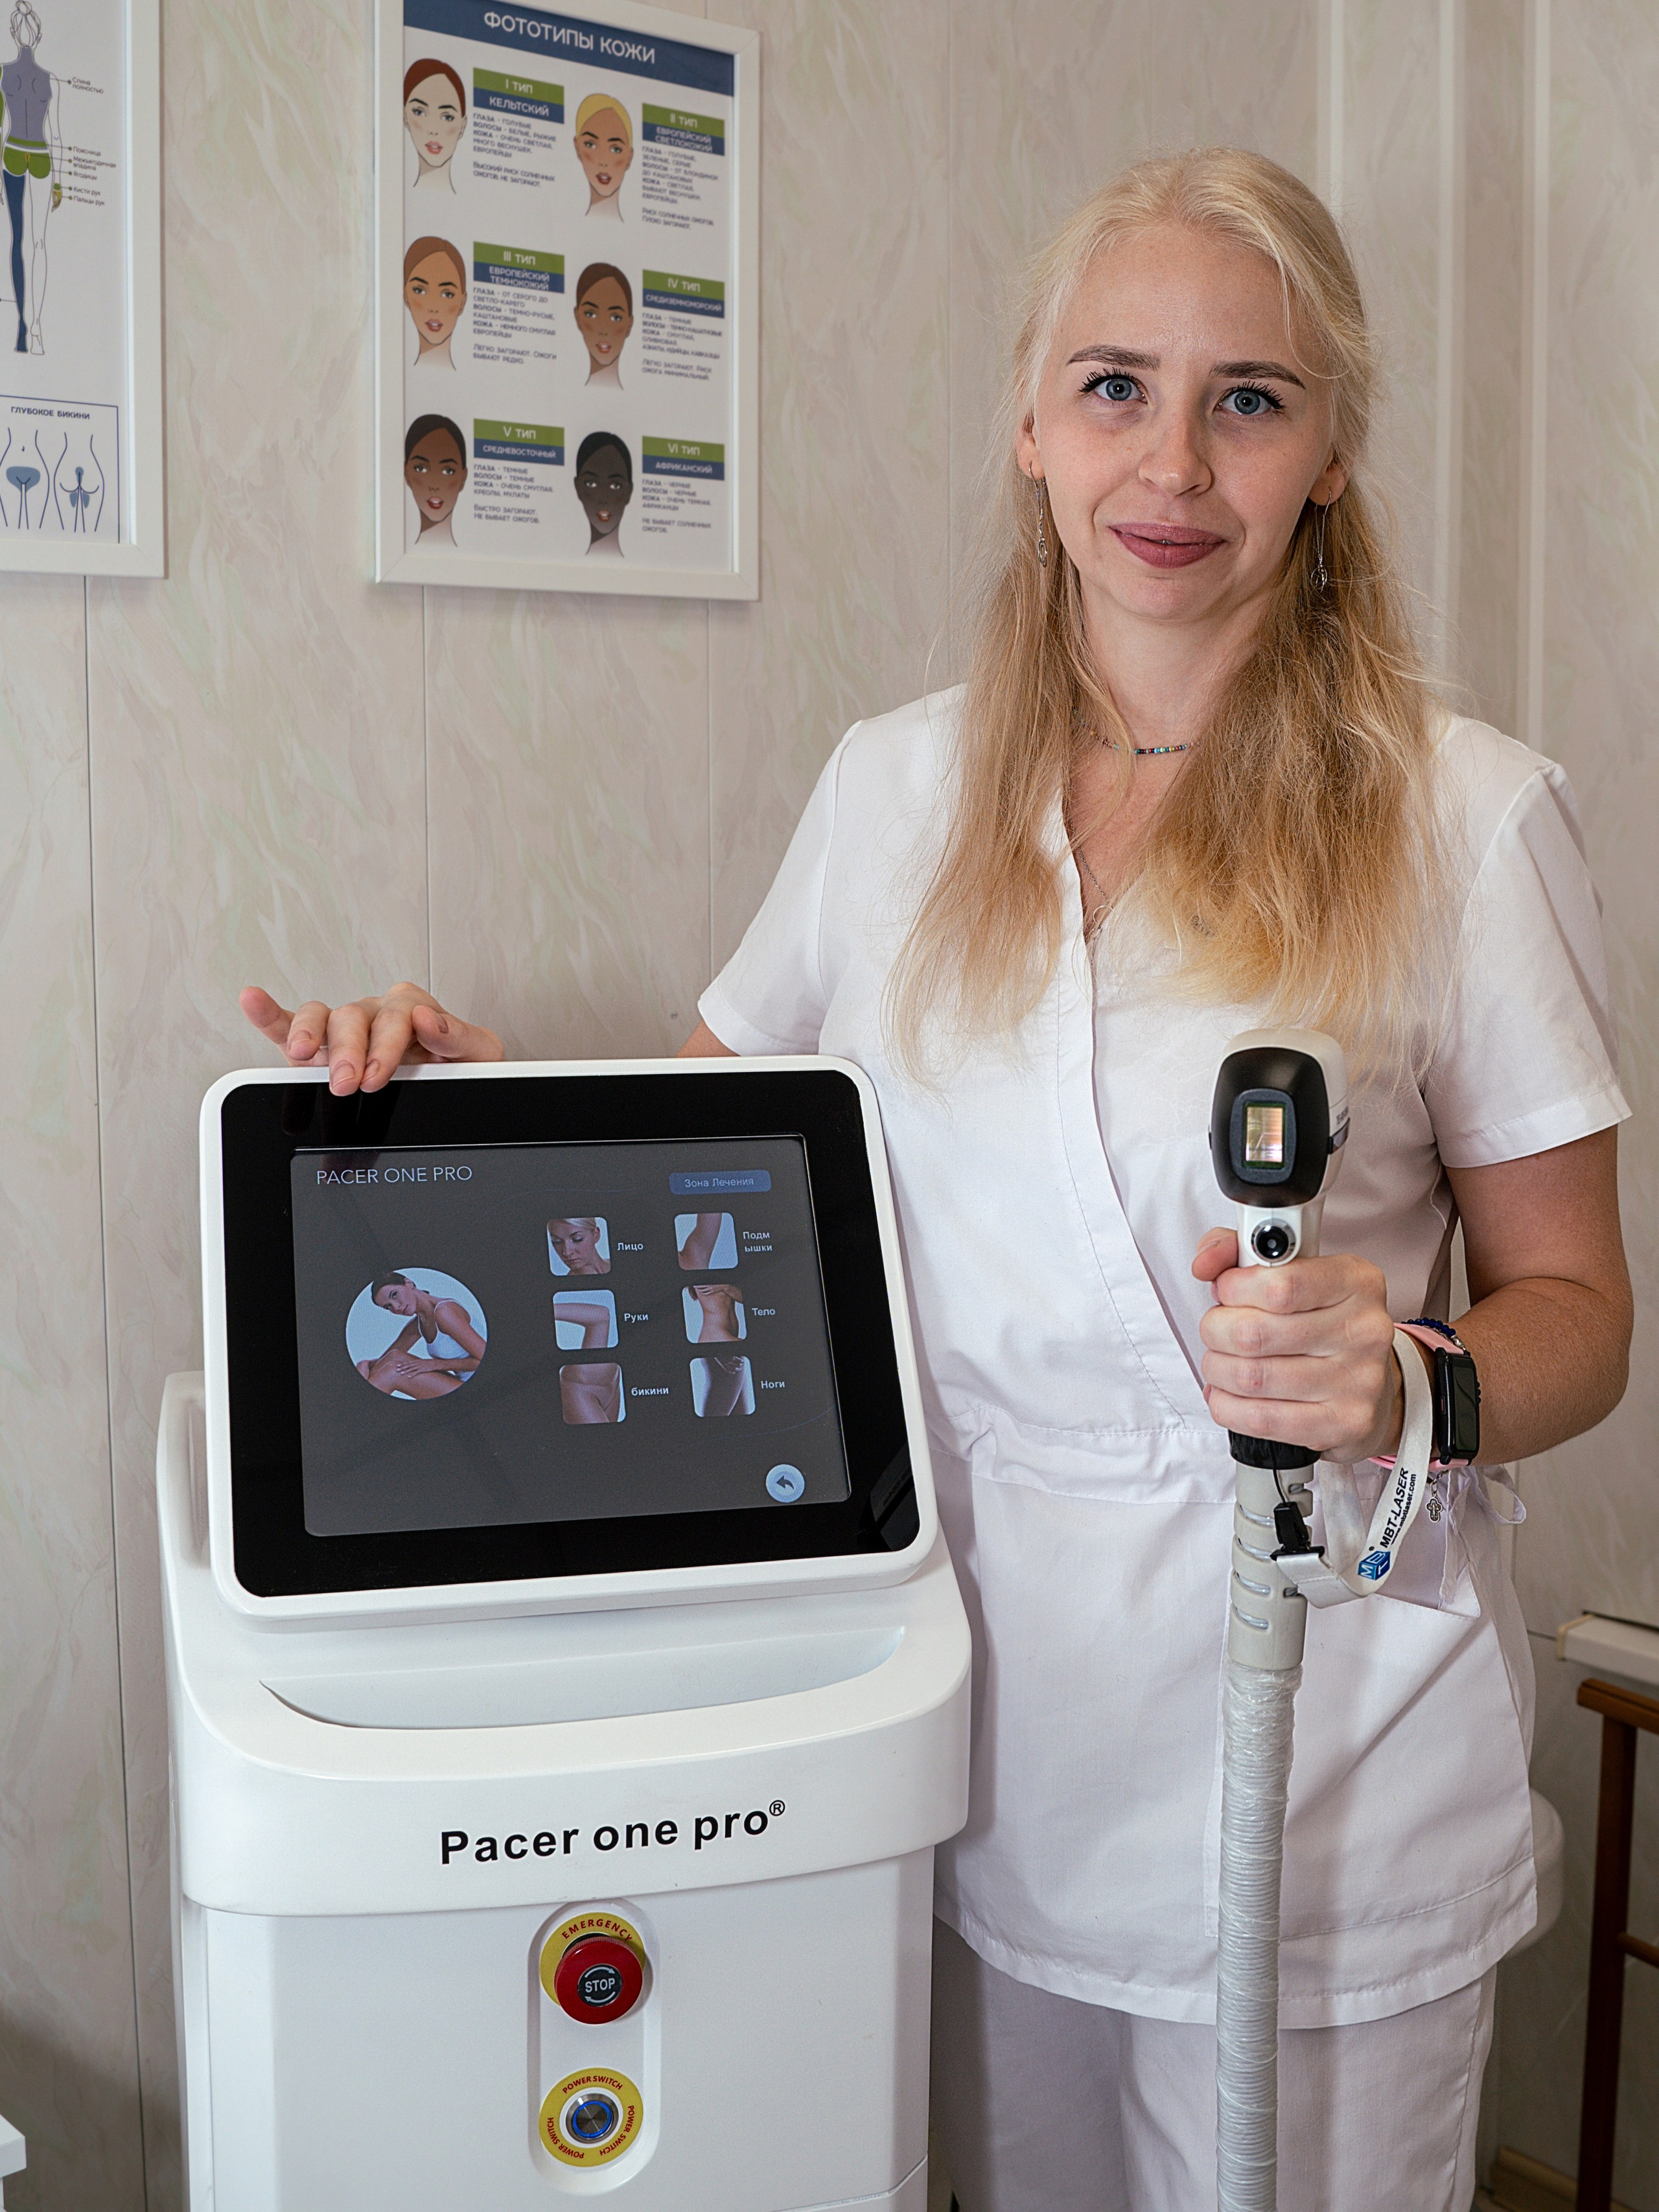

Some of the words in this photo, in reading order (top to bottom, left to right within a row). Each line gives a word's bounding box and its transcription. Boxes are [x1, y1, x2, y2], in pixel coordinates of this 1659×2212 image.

[484, 12, 594, 50] ФОТОТИПЫ
[600, 36, 655, 64] КОЖИ
[73, 77, 91, 86] Спина
[73, 84, 103, 94] полностью
[489, 97, 549, 117] КЕЛЬТСКИЙ
[473, 113, 494, 122] ГЛАЗА
[473, 122, 502, 131] ВОЛОСЫ
[500, 135, 521, 143] ОЧЕНЬ
[656, 126, 712, 144] ЕВРОПЕЙСКИЙ
[656, 135, 712, 152] СВЕТЛОКОЖИЙ
[73, 146, 101, 156] Поясница
[73, 171, 97, 180] Ягодицы
[74, 196, 94, 204] Пальцы
[489, 266, 550, 282] ЕВРОПЕЙСКИЙ
[491, 275, 549, 290] ТЕМНОКОЖИЙ
[474, 296, 525, 307] СВЕТЛО-КАРЕГО
[513, 293, 537, 301] СЕРОГО
[474, 312, 517, 322] КАШТАНОВЫЕ
[11, 406, 54, 416] ГЛУБОКОЕ
[57, 411, 89, 419] БИКИНИ
[504, 426, 511, 437] V
[483, 445, 556, 459] СРЕДНЕВОСТОЧНЫЙ
[668, 443, 678, 454] VI
[656, 462, 712, 474] АФРИКАНСКИЙ
[318, 1169, 378, 1184] PACER
[385, 1167, 427, 1183] ONE
[434, 1167, 472, 1181] PRO
[684, 1179, 709, 1187] Зона
[712, 1178, 754, 1187] Лечения
[743, 1231, 770, 1240] Подм
[618, 1242, 644, 1251] Лицо
[624, 1313, 649, 1323] Руки
[631, 1387, 669, 1396] бикини
[1380, 1467, 1409, 1548] MBT-LASER
[441, 1828, 579, 1865] Pacer
[594, 1820, 678, 1851] one
[562, 1919, 633, 1941] EMERGENCY
[585, 1977, 615, 1993] STOP
[563, 2076, 592, 2094] POWER
[593, 2076, 623, 2090] SWITCH
[626, 2106, 634, 2133] POWER
[548, 2117, 560, 2145] SWITCH
[559, 2143, 585, 2159] POWER
[599, 2134, 626, 2156] SWITCH
